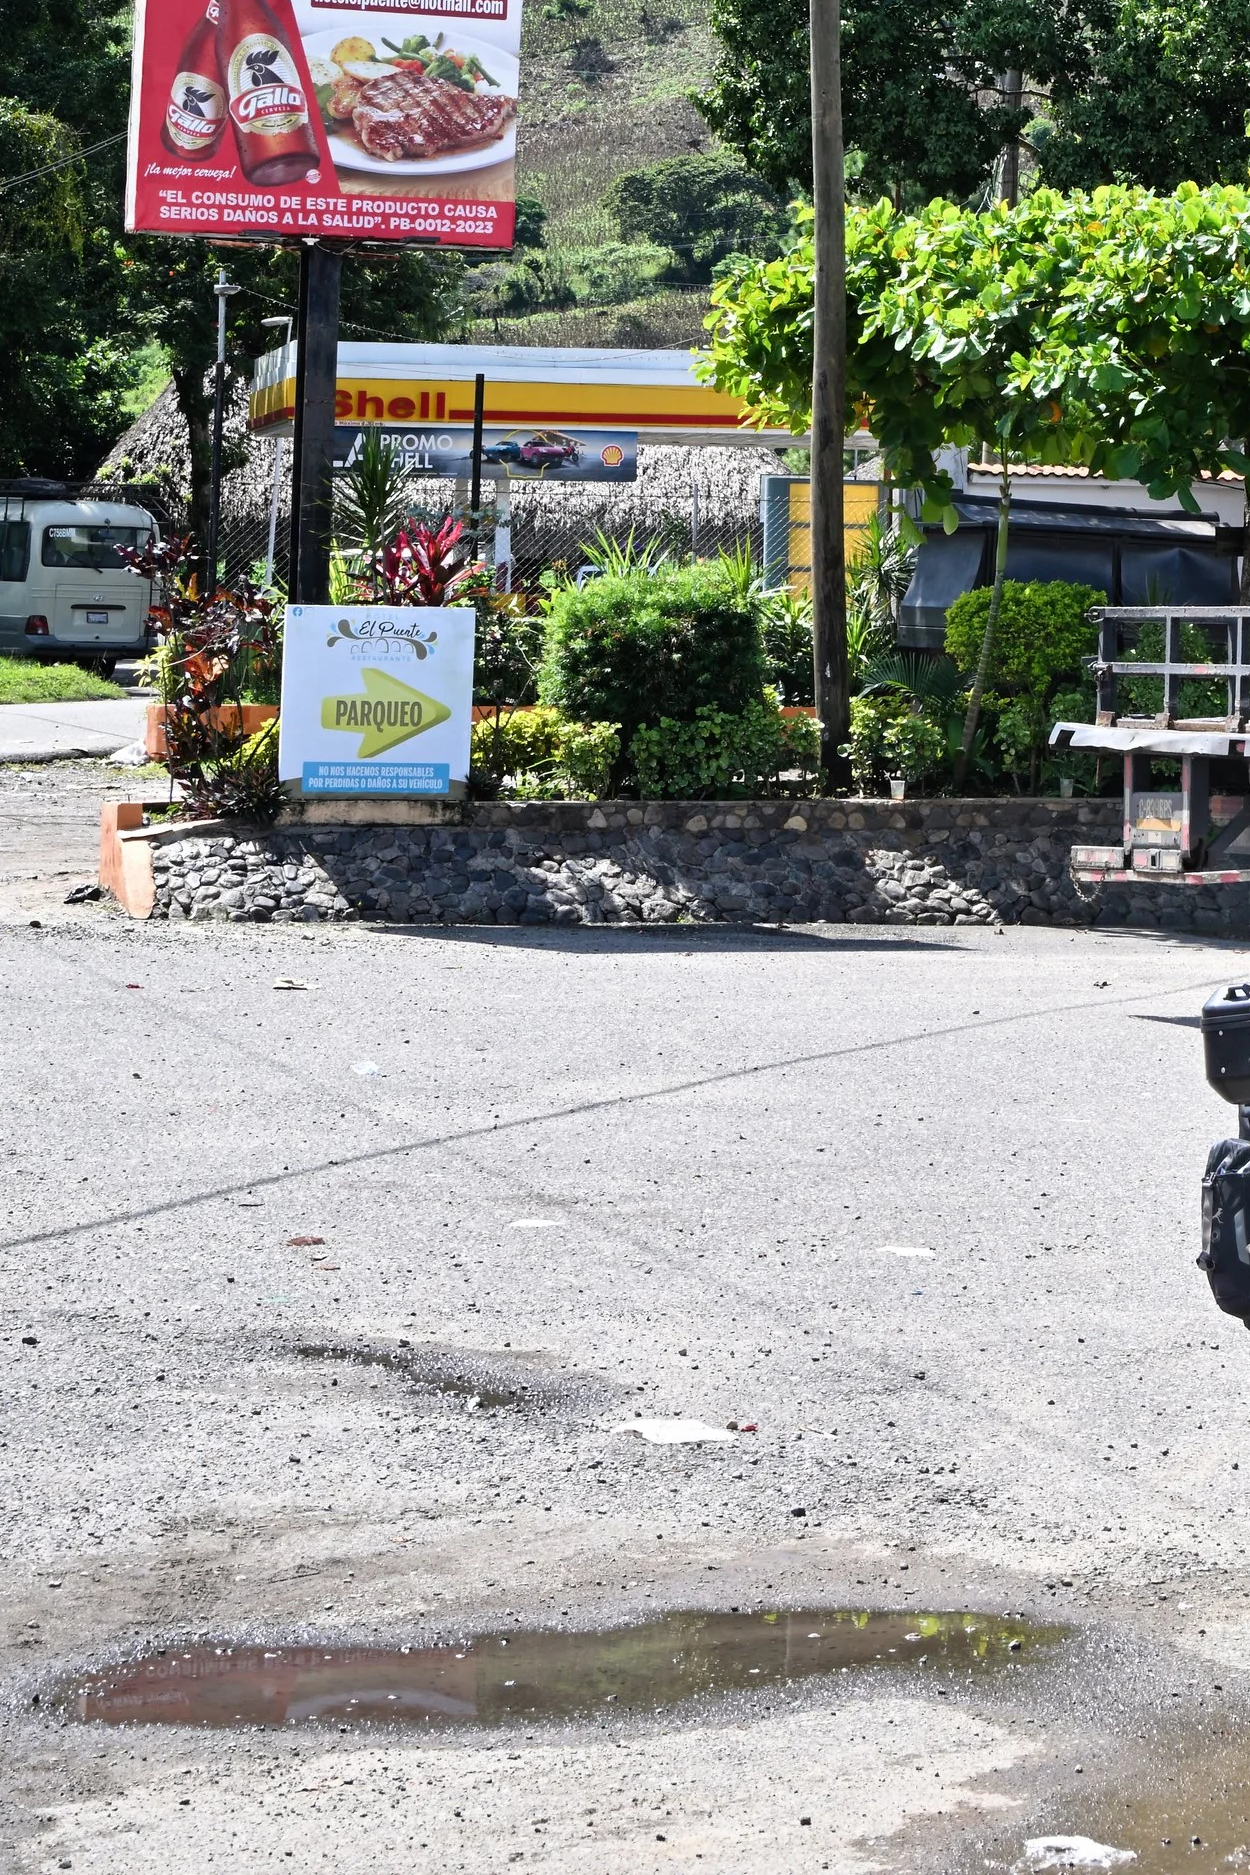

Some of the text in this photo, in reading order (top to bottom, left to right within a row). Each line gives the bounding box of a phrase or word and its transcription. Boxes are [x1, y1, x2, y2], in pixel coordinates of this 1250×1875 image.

[261, 106, 291, 114] CERVEZA
[163, 165, 192, 179] mejor
[194, 166, 237, 181] cerveza!
[191, 192, 275, 208] CONSUMO
[280, 196, 301, 208] DE
[306, 197, 346, 211] ESTE
[352, 200, 439, 215] PRODUCTO
[444, 205, 498, 219] CAUSA
[159, 206, 218, 221] SERIOS
[223, 208, 278, 224] DAÑOS
[282, 213, 294, 224] A
[298, 213, 318, 226] LA
[390, 218, 494, 234] PB-0012-2023
[380, 434, 453, 451] PROMO
[359, 621, 422, 638] El Puente
[336, 700, 422, 733] PARQUEO
[319, 766, 434, 777] NO NOS HACEMOS RESPONSABLES
[309, 776, 443, 789] POR PERDIDAS O DAÑOS A SU VEHÍCULO
